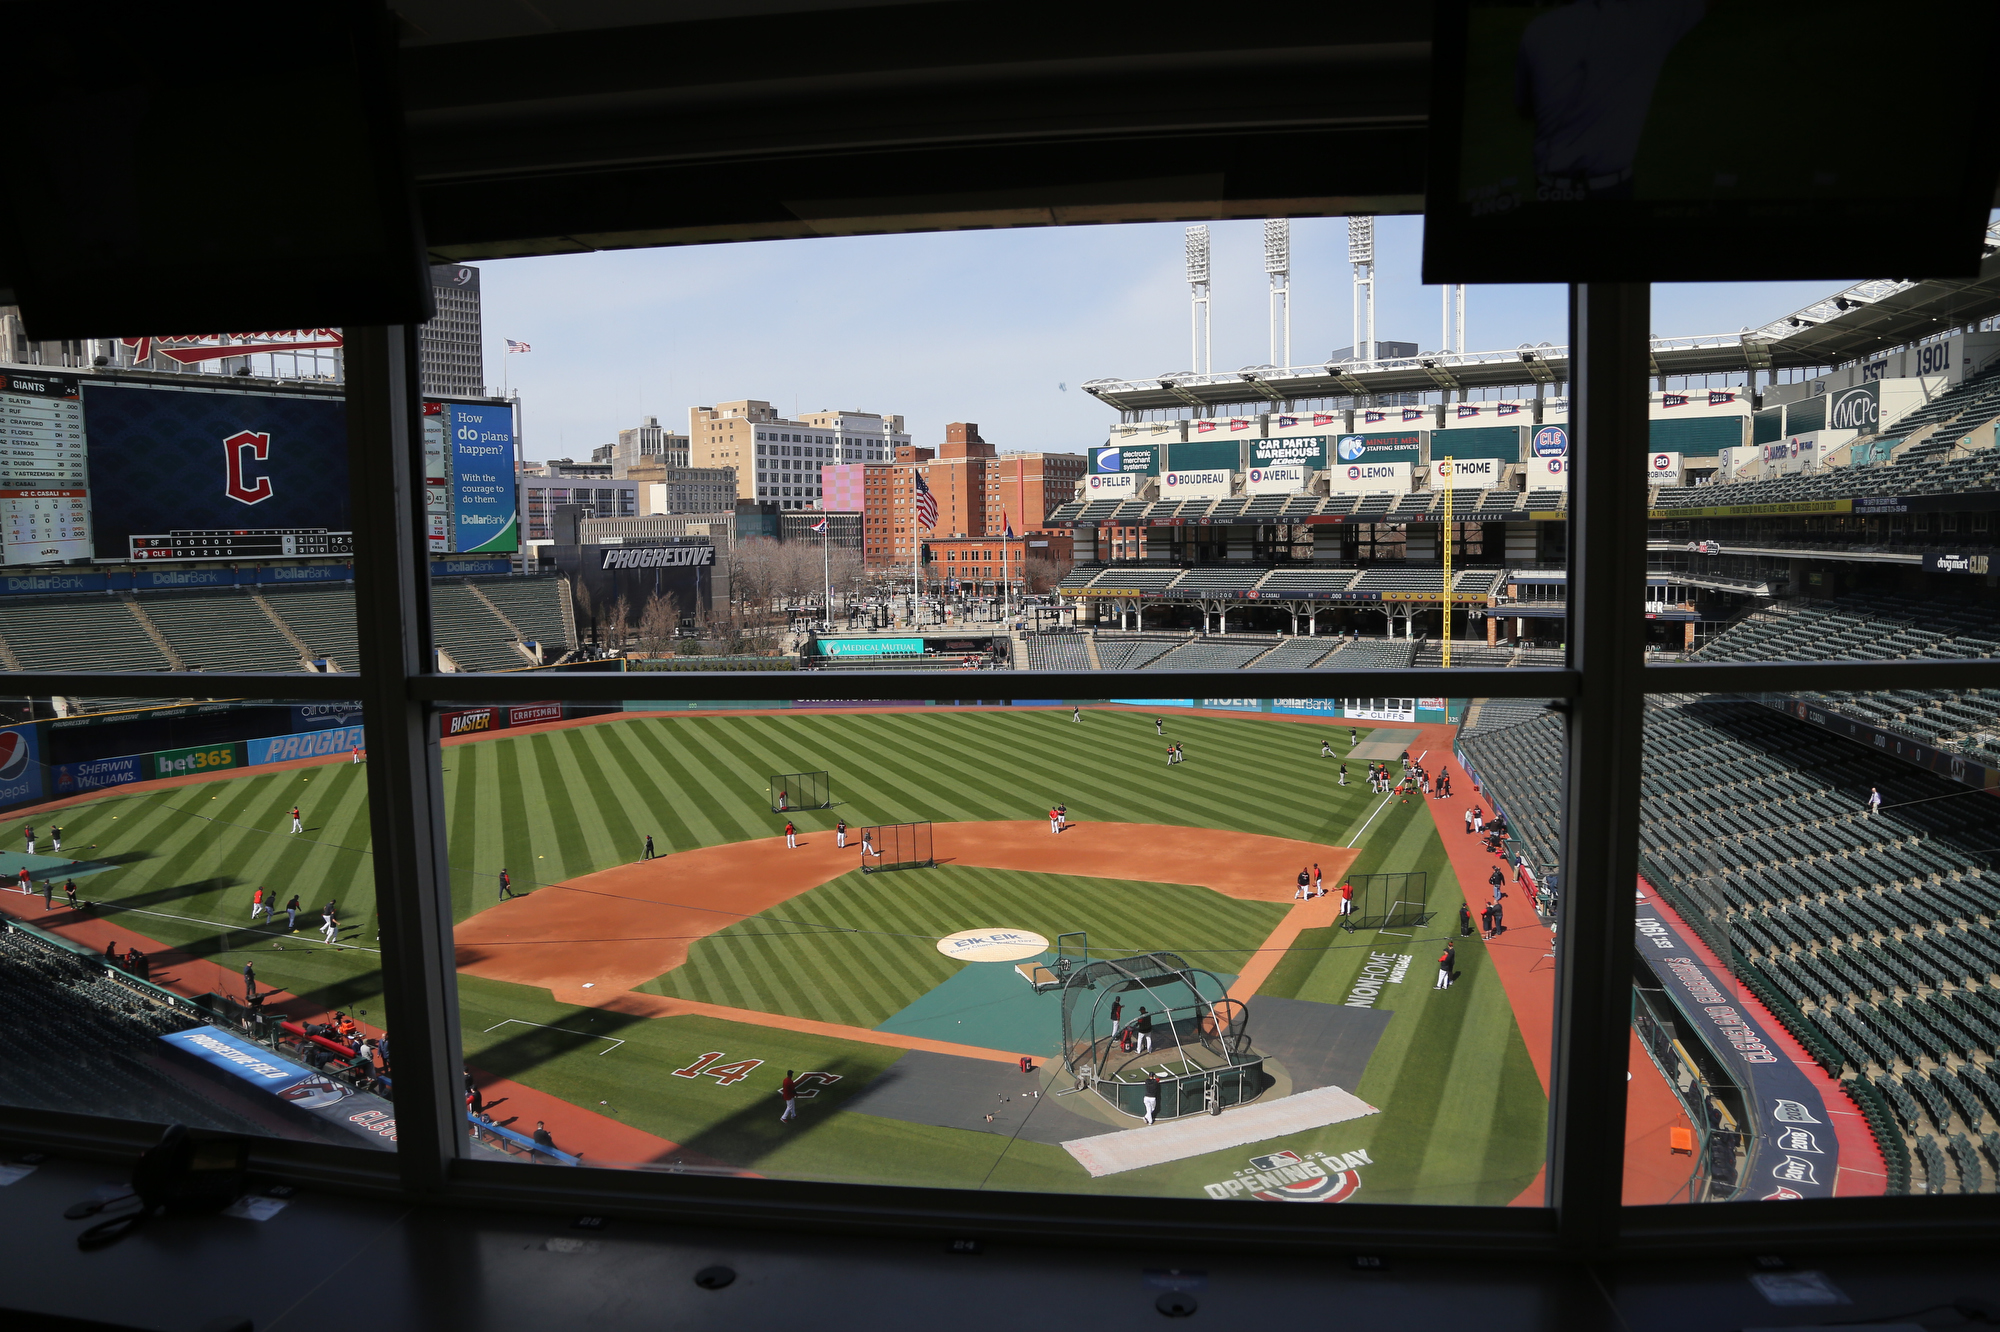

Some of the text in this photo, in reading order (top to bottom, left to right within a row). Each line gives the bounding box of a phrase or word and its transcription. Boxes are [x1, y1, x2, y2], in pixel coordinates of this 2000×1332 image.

[458, 268, 472, 286] 9
[1916, 341, 1950, 377] 1901
[13, 380, 46, 392] GIANTS
[1665, 397, 1681, 405] 2017
[10, 418, 44, 427] CRAWFORD
[457, 412, 483, 424] How
[1366, 413, 1379, 421] 1998
[457, 425, 478, 441] do
[480, 431, 509, 444] plans
[1399, 436, 1419, 444] MEN
[1540, 431, 1562, 445] CLE
[1259, 437, 1317, 449] CAR PARTS
[458, 443, 503, 456] happen?
[1123, 450, 1150, 458] electronic
[1256, 447, 1320, 459] WAREHOUSE
[1123, 456, 1150, 465] merchant
[1550, 462, 1560, 470] 14
[1655, 457, 1669, 466] 20
[222, 429, 274, 506] C
[1123, 463, 1150, 471] systems
[1350, 466, 1395, 478] 21 LEMON
[1454, 462, 1491, 474] THOME
[461, 473, 497, 483] With the
[1169, 473, 1225, 485] 5 BOUDREAU
[1253, 469, 1300, 480] 3 AVERILL
[1102, 477, 1131, 487] FELLER
[462, 484, 505, 495] courage to
[463, 495, 498, 504] do them.
[461, 514, 507, 525] DollarBank
[446, 558, 495, 571] DollarBank
[602, 547, 714, 570] PROGRESSIVE
[1952, 558, 1968, 570] mart
[1969, 555, 1989, 574] CLUB
[152, 570, 218, 585] DollarBank
[274, 566, 331, 580] DollarBank
[8, 576, 84, 591] DollarBank
[842, 642, 917, 652] MEDICAL MUTUAL
[198, 703, 230, 712] PROGRESSIVE
[1273, 698, 1333, 711] DollarBank
[102, 713, 139, 722] PROGRESSIVE
[151, 708, 187, 717] PROGRESSIVE
[1371, 711, 1404, 721] CLIFFS
[52, 719, 90, 728] PROGRESSIVE
[450, 712, 491, 734] BLASTER
[158, 748, 233, 773] bet365
[77, 760, 133, 776] SHERWIN
[954, 933, 1023, 948] Elk Elk
[1386, 954, 1413, 984] MORTGAGE
[183, 1033, 292, 1079] PROGRESSIVE FIELD
[671, 1051, 765, 1086] 14
[1791, 1132, 1808, 1150] 2018
[1233, 1151, 1327, 1178] 20 22
[1785, 1160, 1806, 1180] 2017
[1203, 1148, 1374, 1200] OPENING DAY
